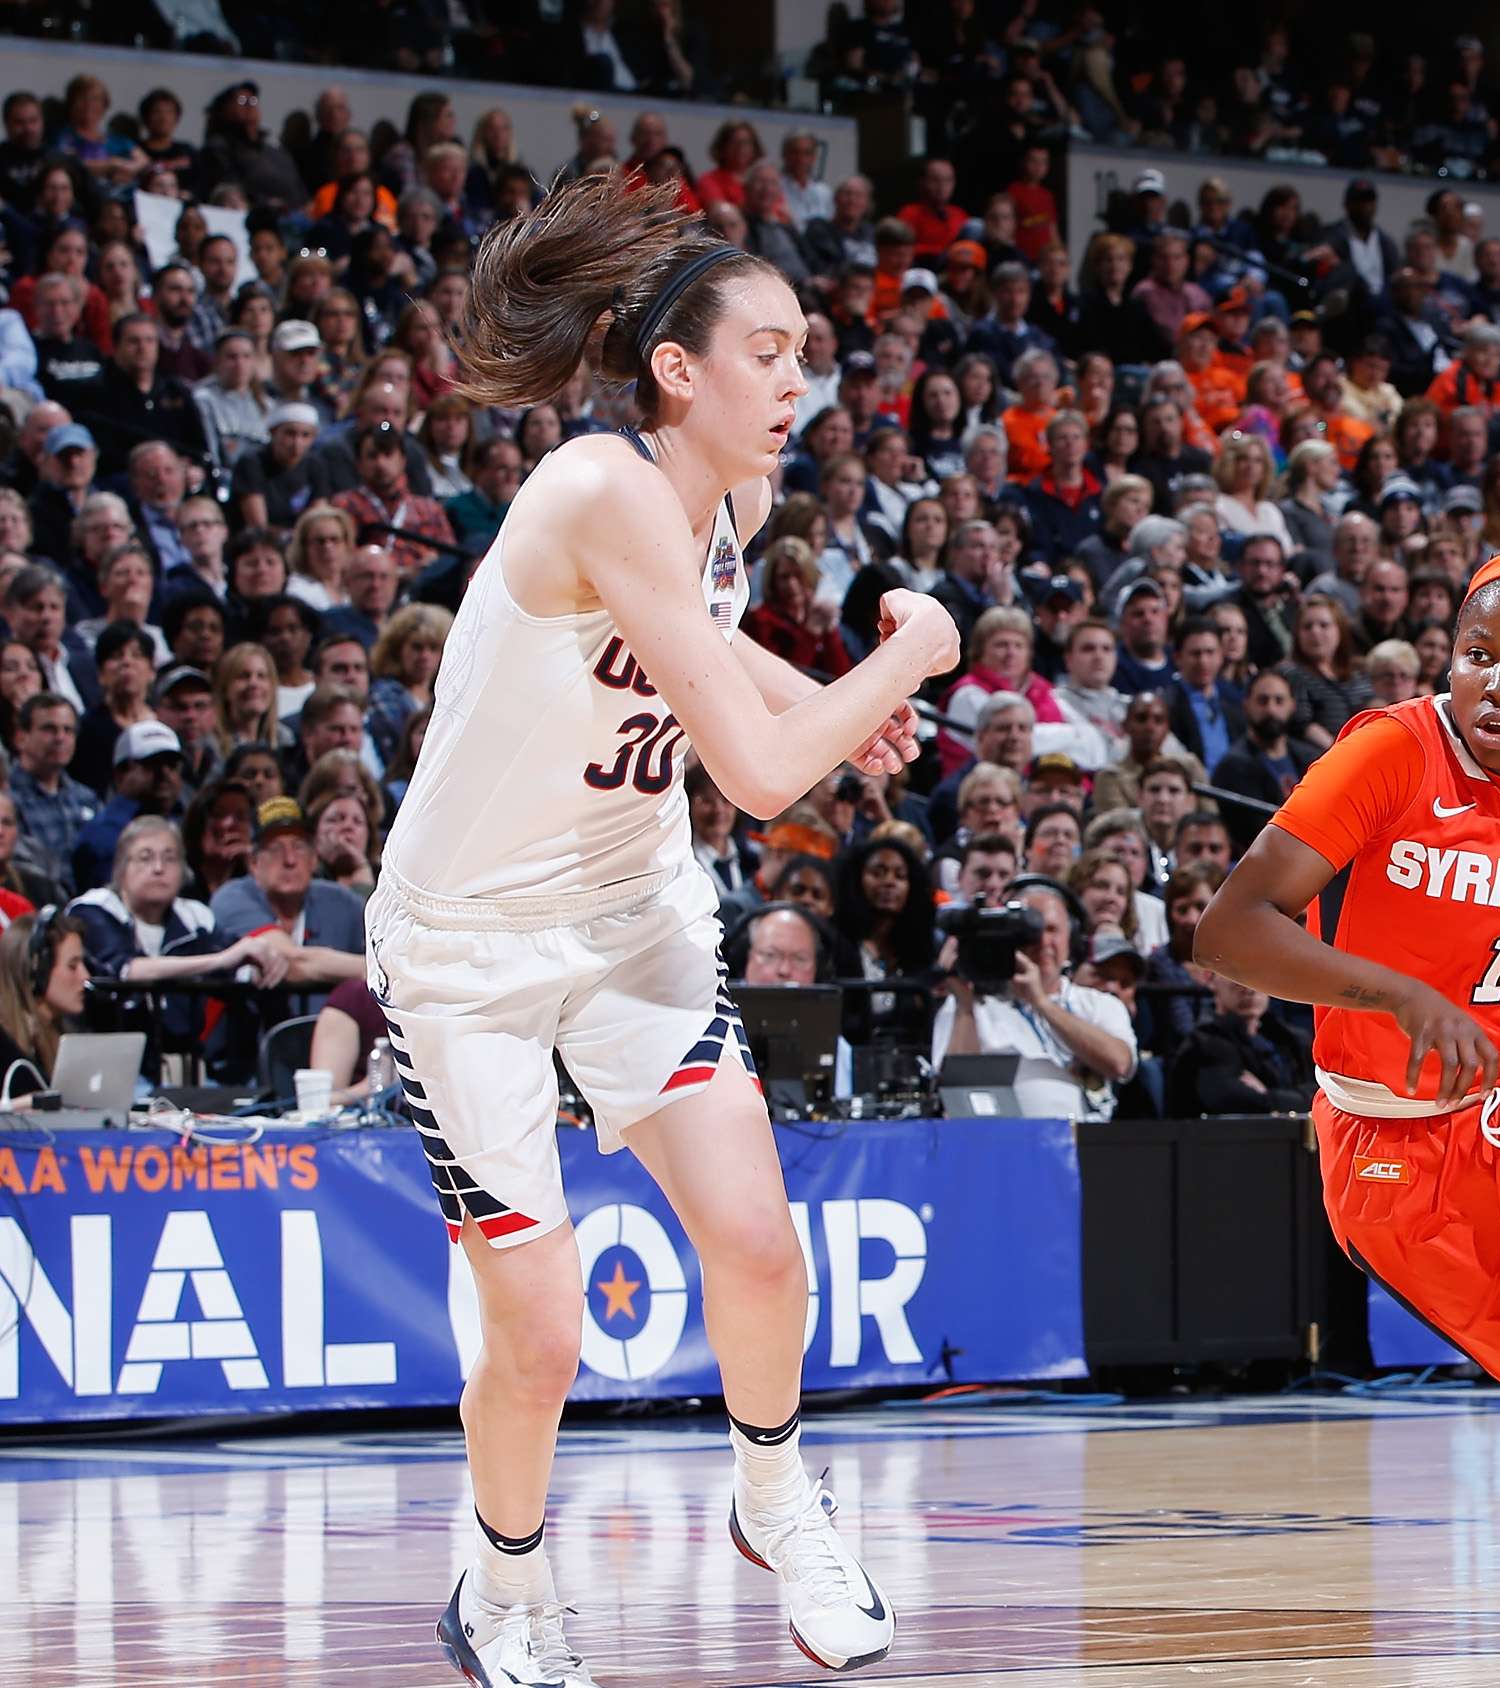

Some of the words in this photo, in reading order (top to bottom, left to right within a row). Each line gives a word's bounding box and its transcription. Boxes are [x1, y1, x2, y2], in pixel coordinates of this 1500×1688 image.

[582, 712, 687, 796] 30
[79, 1144, 319, 1192] WOMEN'S
[1360, 1162, 1402, 1179] ACC
